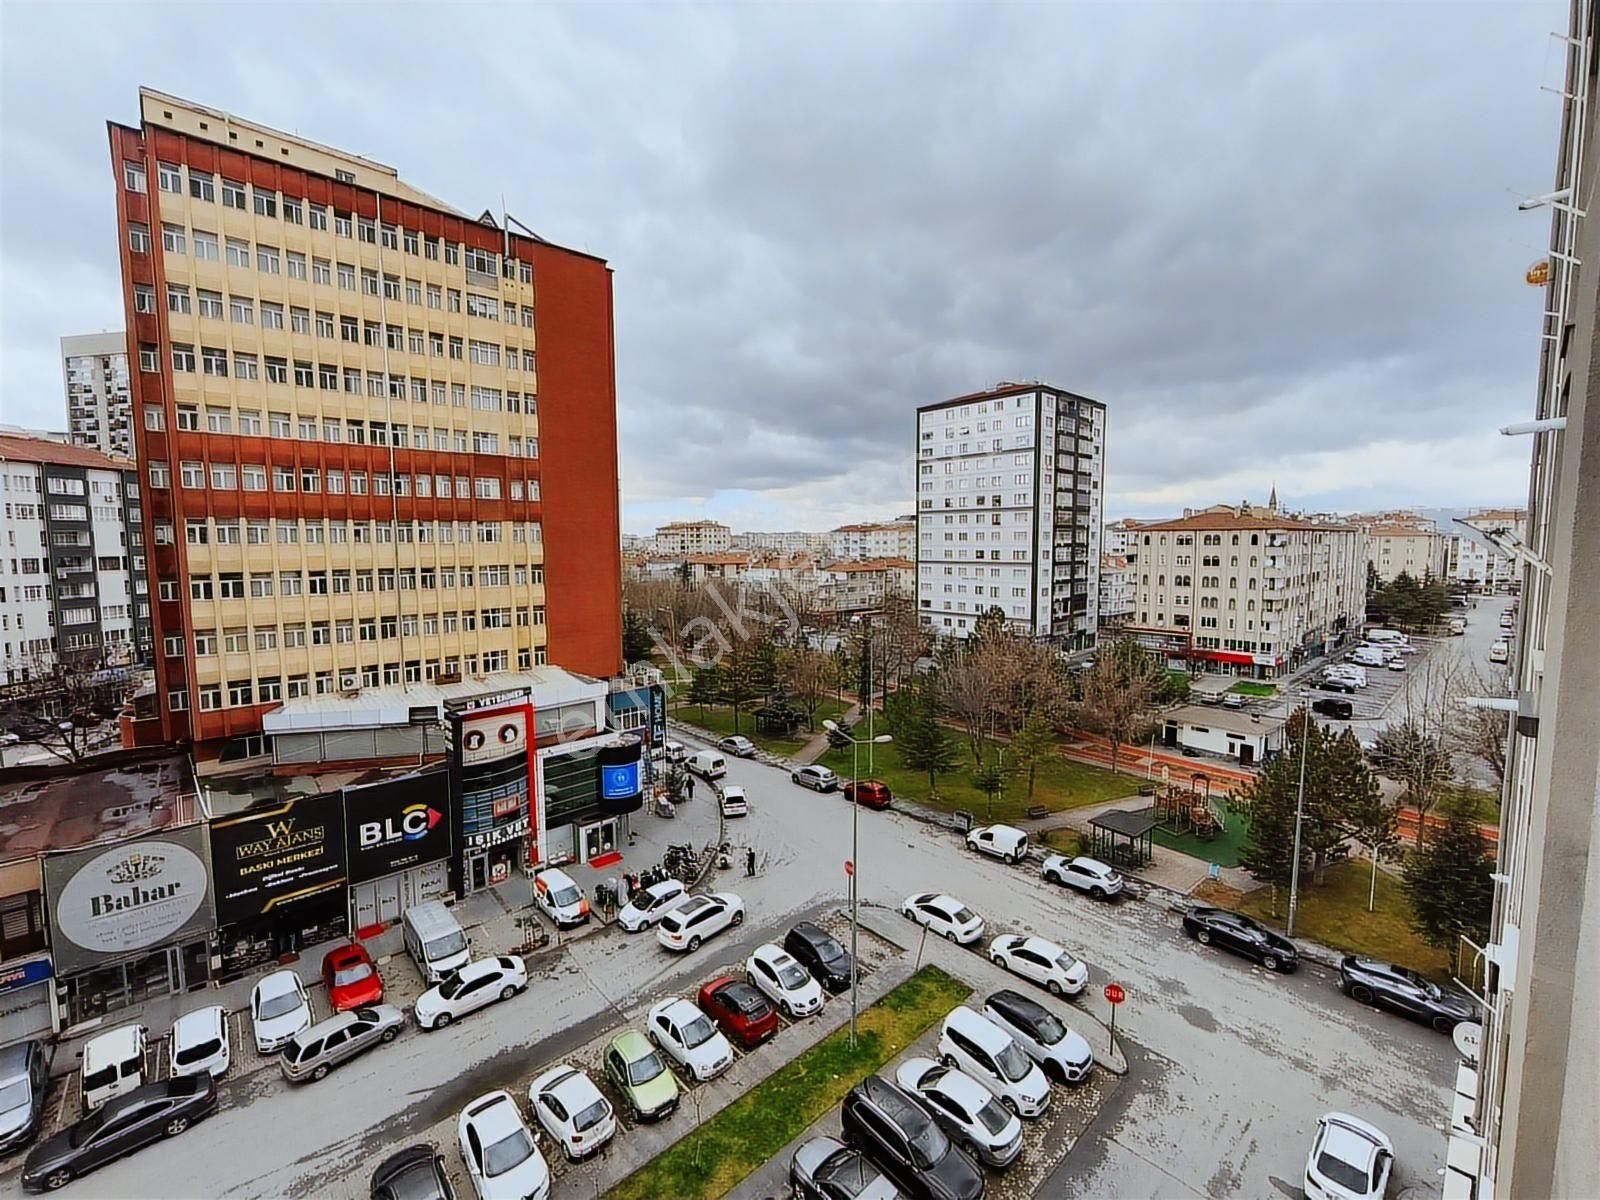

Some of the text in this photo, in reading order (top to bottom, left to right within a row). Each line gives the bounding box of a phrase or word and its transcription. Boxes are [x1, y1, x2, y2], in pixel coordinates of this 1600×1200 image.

[238, 840, 272, 857] WAY
[276, 827, 322, 847] AJANS
[360, 811, 428, 846] BLC
[239, 860, 274, 876] BASKI
[90, 881, 182, 917] Bahar
[1105, 989, 1123, 1000] DUR
